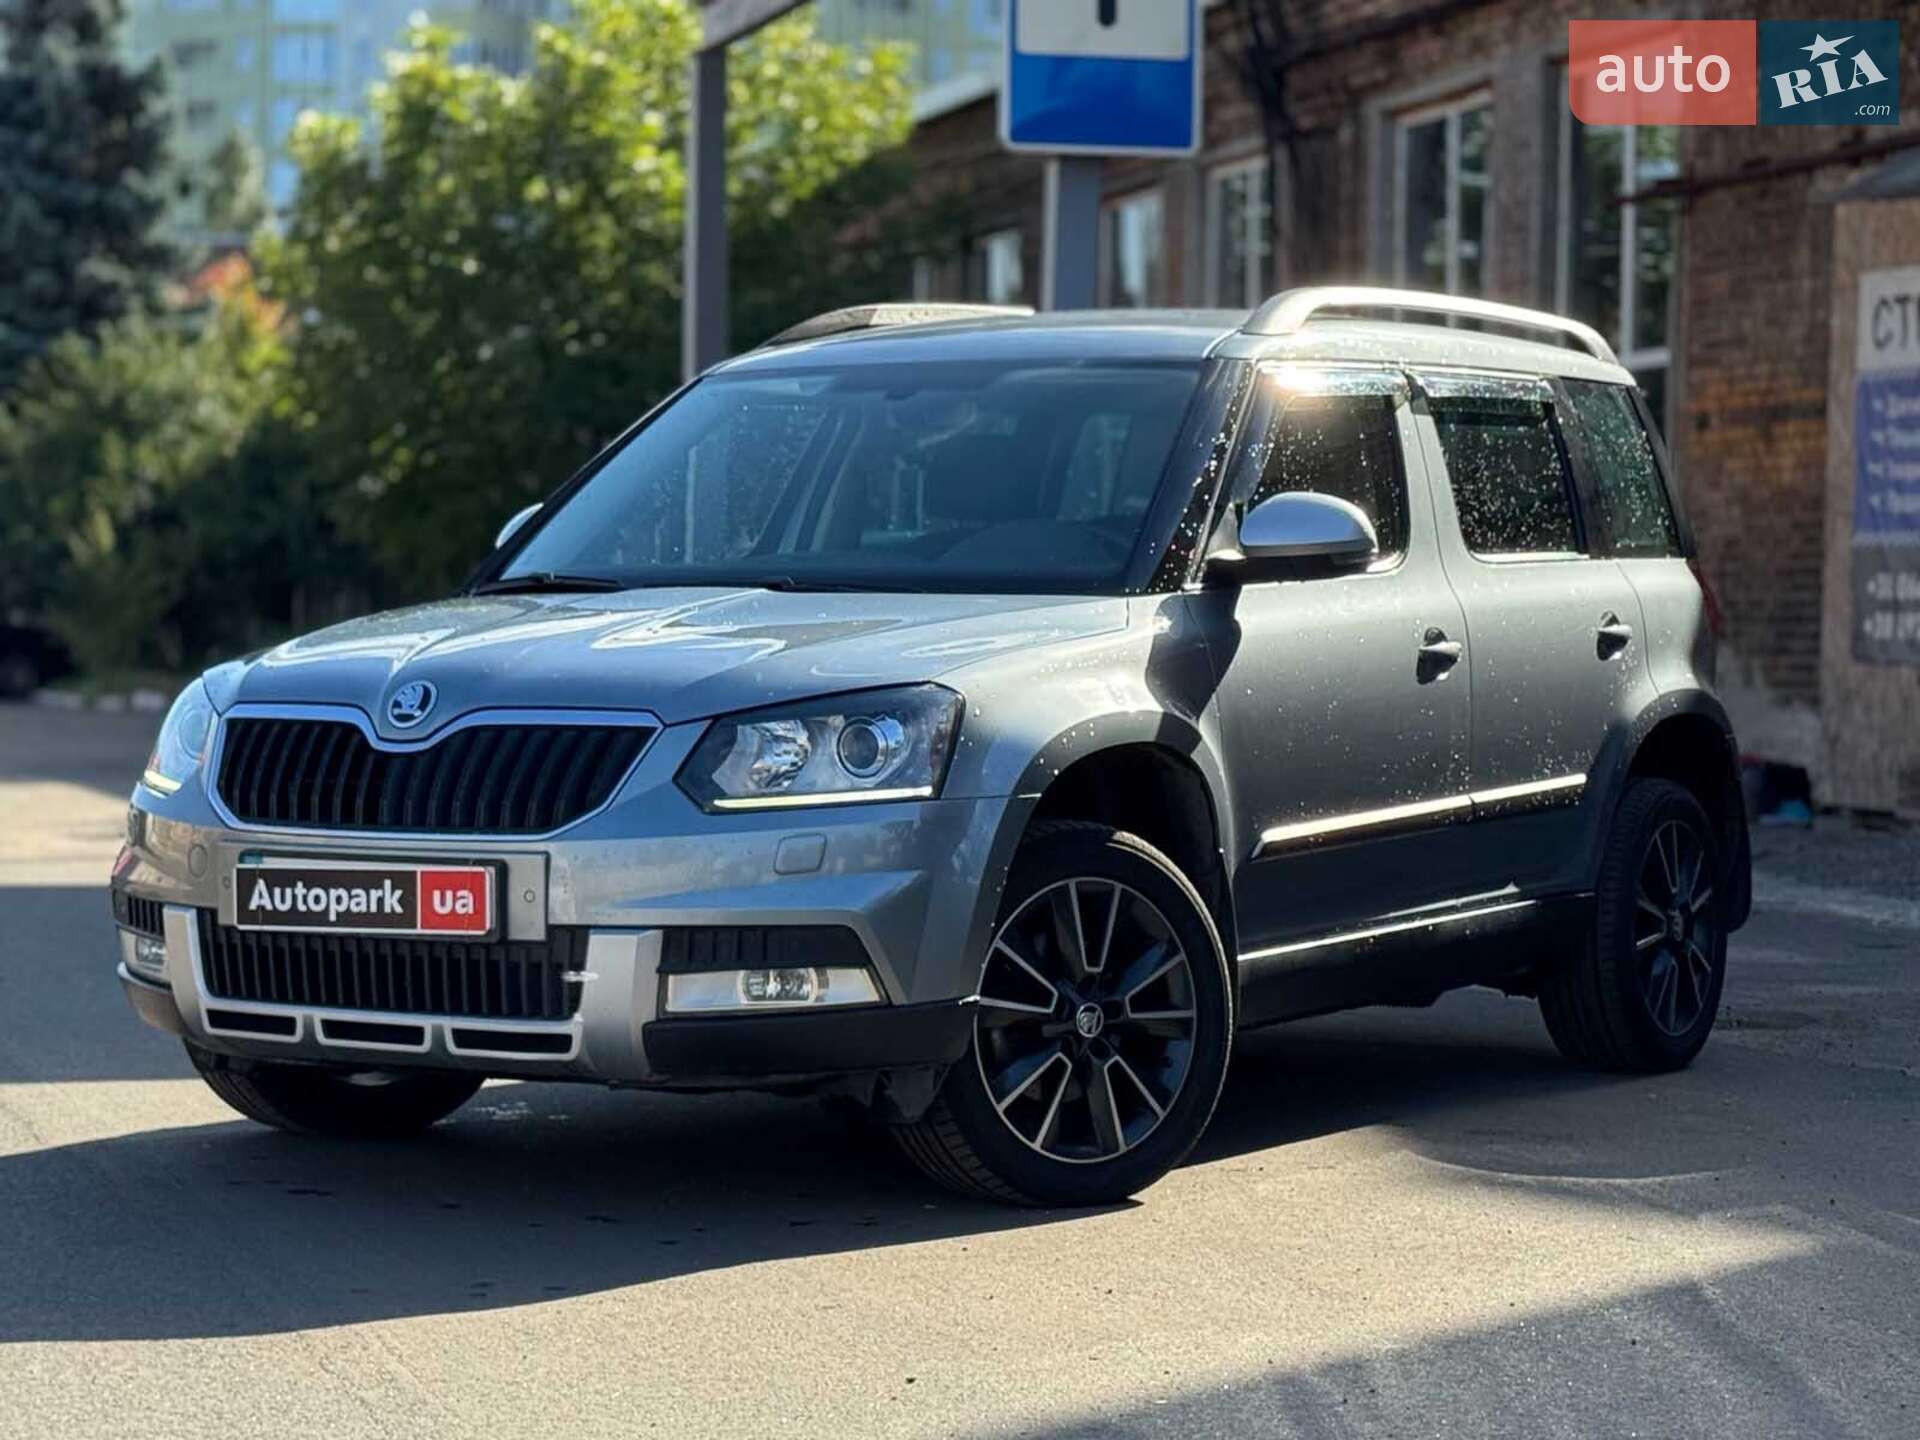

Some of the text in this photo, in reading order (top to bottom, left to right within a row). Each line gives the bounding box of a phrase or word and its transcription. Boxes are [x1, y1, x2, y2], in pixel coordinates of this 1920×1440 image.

[1871, 293, 1920, 351] СТ
[248, 878, 475, 922] Autopark ua
